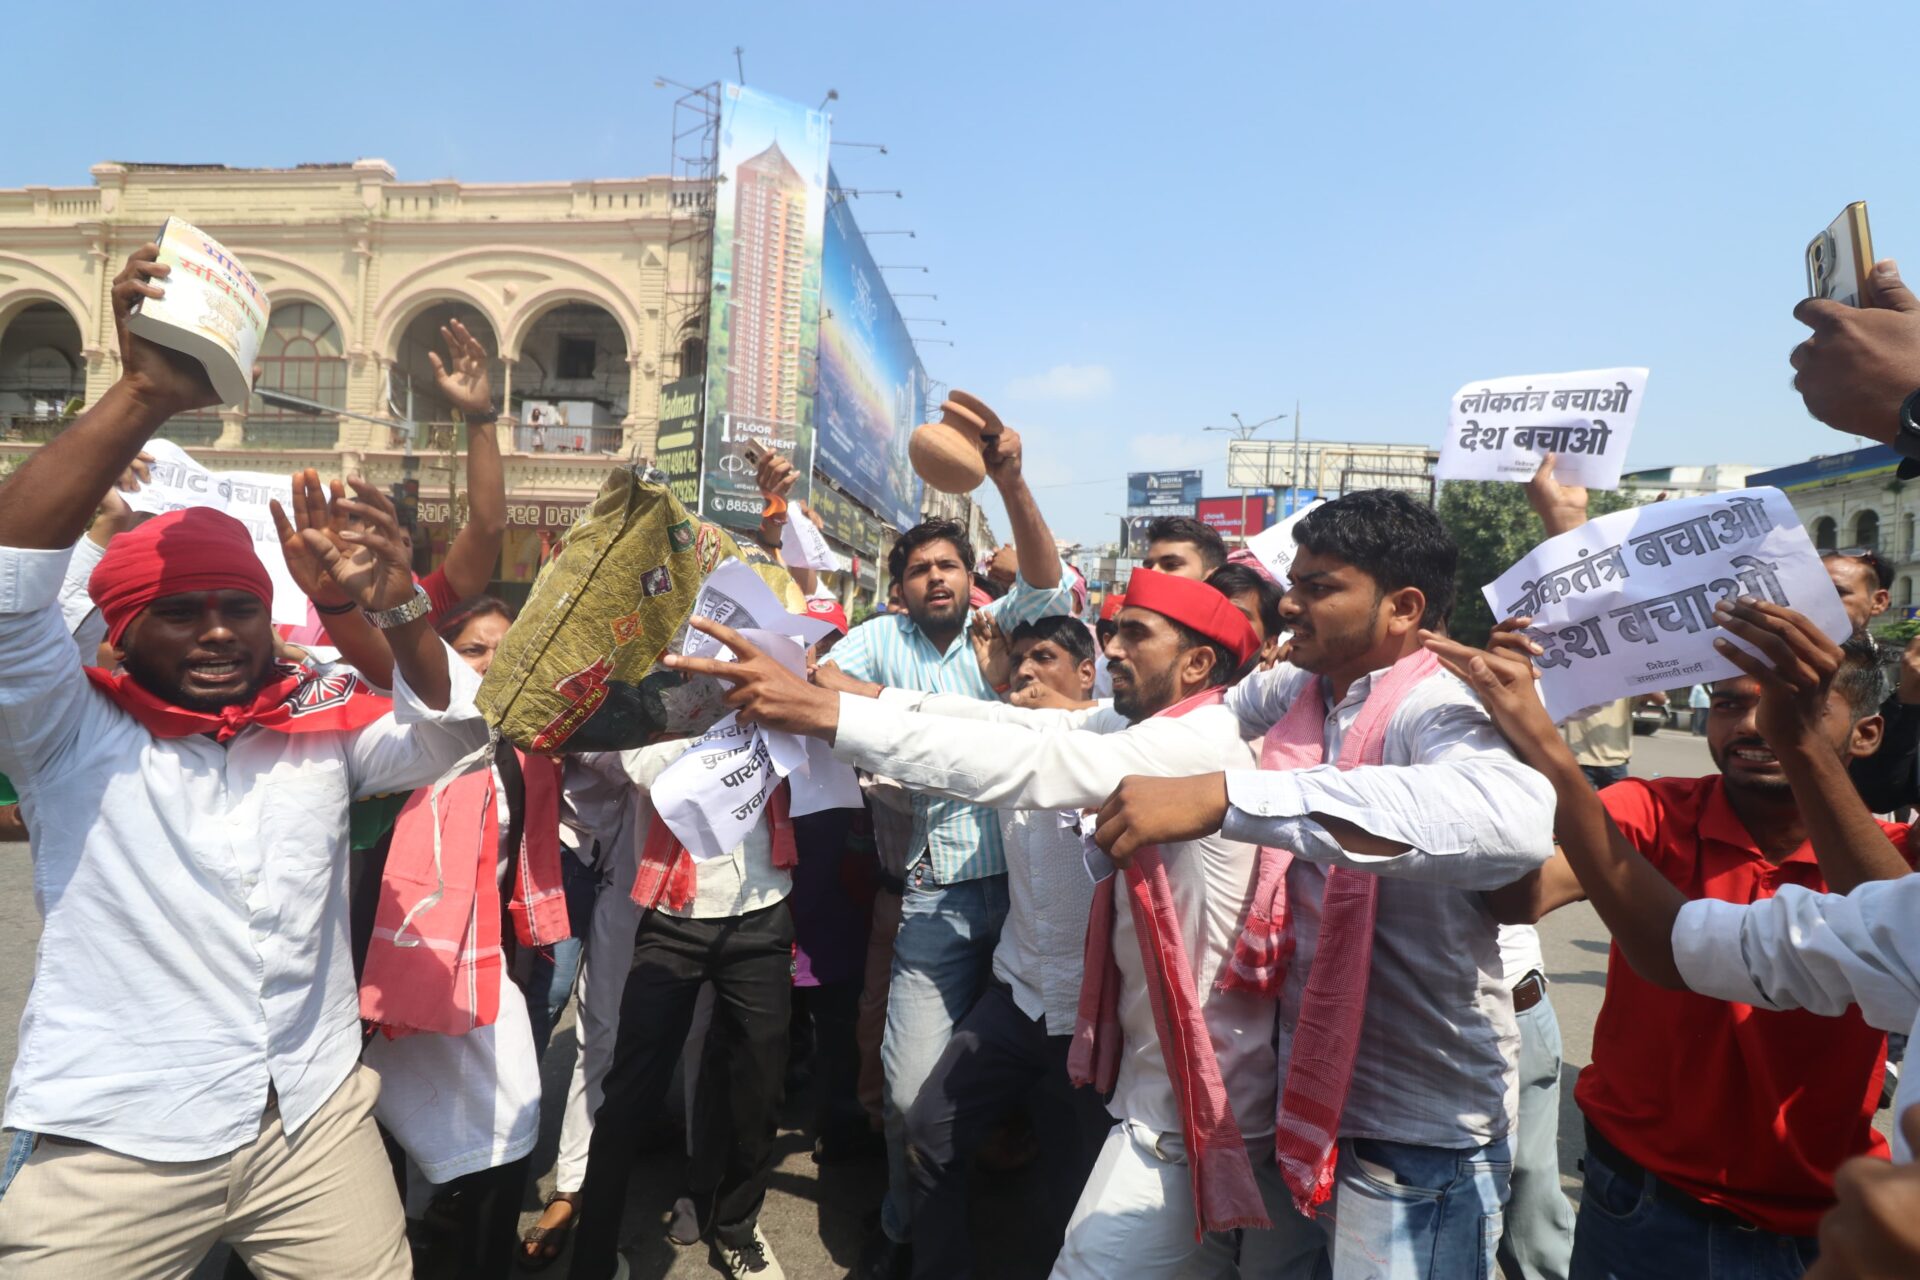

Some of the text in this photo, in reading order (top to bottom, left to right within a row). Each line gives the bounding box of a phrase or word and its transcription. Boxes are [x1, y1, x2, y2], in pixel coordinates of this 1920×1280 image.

[202, 242, 257, 298] भारत
[178, 255, 260, 331] संविधान
[1459, 381, 1632, 414] लोकतंत्र बचाओ
[734, 433, 797, 449] APTMENT
[736, 422, 772, 435] FLOOR
[1459, 419, 1612, 456] देश बचाओ
[726, 498, 763, 514] 88538
[1506, 496, 1774, 618] लोकतंत्र बचाओ
[1608, 554, 1790, 645] बचाओ
